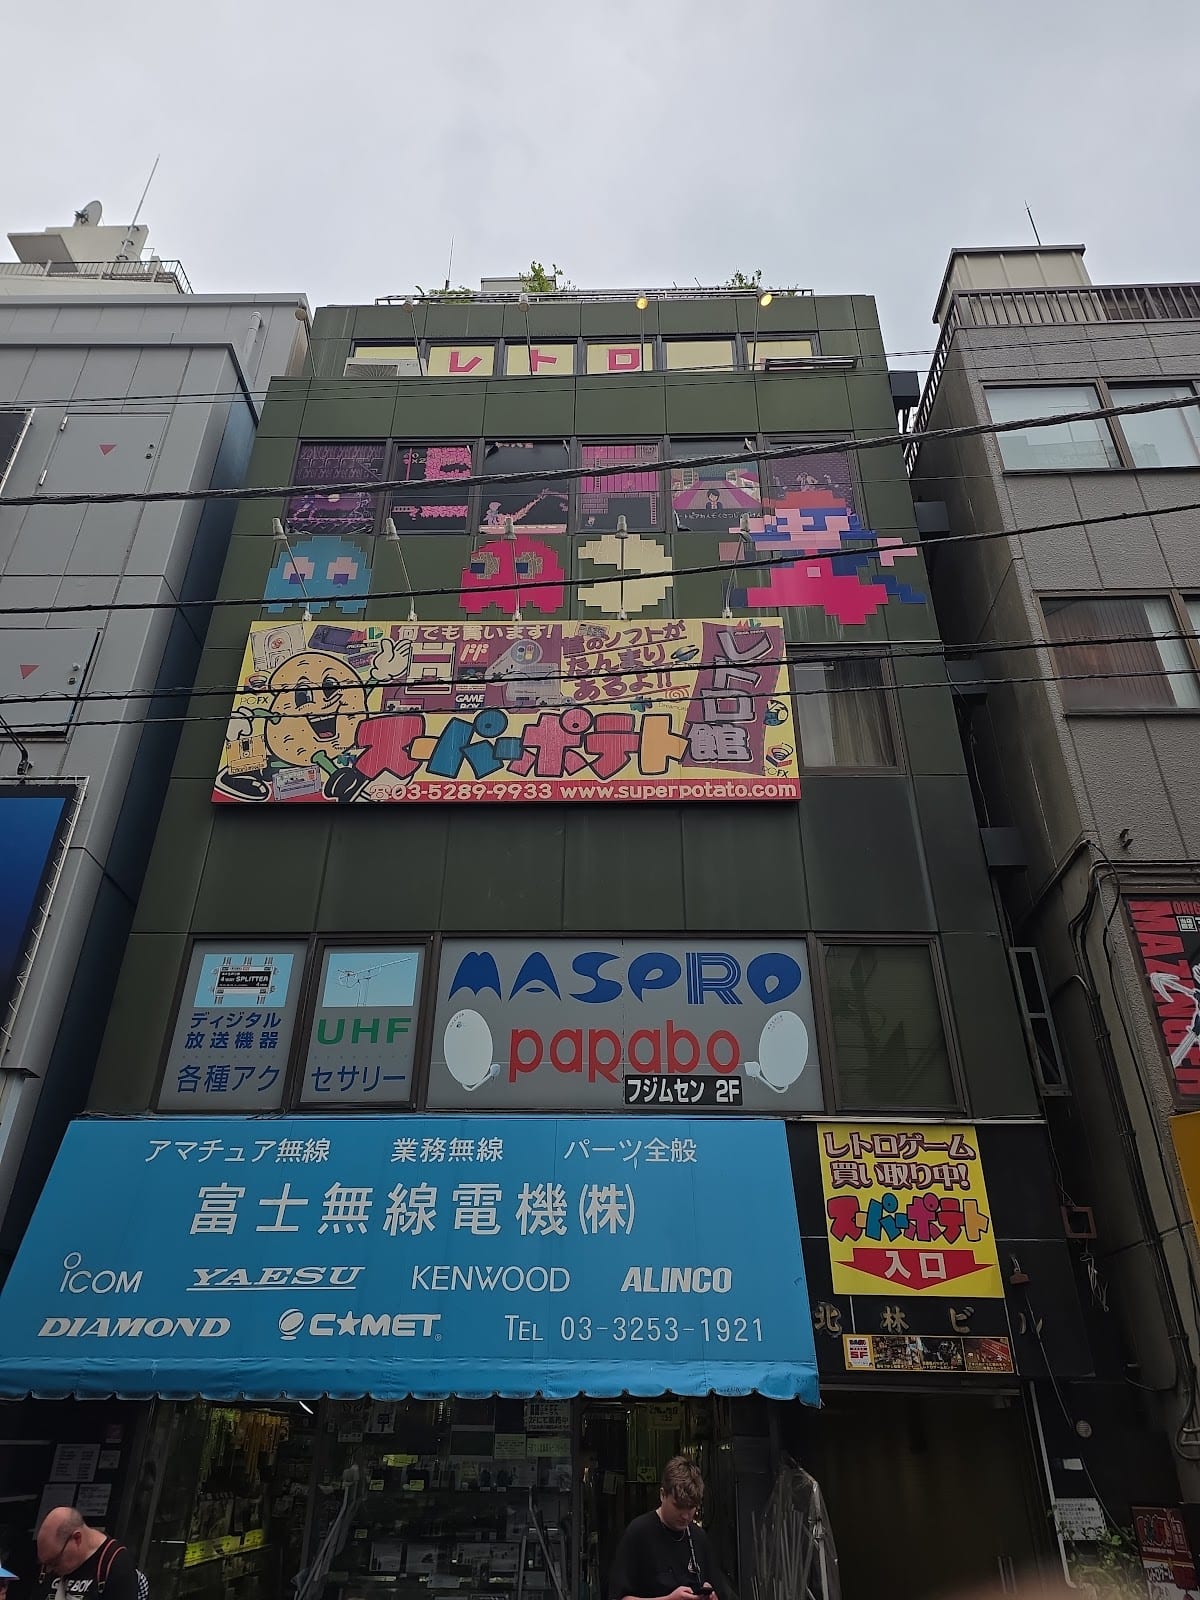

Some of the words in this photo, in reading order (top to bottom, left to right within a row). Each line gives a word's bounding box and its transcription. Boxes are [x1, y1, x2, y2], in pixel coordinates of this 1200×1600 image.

[398, 624, 554, 641] 何でも買います!
[455, 694, 485, 703] GAME
[355, 707, 689, 780] スーパーポテト
[390, 783, 552, 802] 03-5289-9933
[559, 782, 797, 801] www.superpotato.com
[235, 975, 269, 983] SPLITTER
[448, 951, 802, 1005] MASPRO
[190, 1012, 282, 1030] ディジタル
[317, 1017, 412, 1046] UHF
[184, 1031, 279, 1050] 放送機器
[177, 1064, 280, 1093] 各種アク
[311, 1066, 407, 1093] セサリー
[627, 1078, 705, 1104] フジムセン
[714, 1079, 741, 1103] 2F
[144, 1139, 330, 1164] アマチュア無線
[391, 1138, 504, 1163] 業務無線
[564, 1137, 698, 1165] パーツ全般
[824, 1131, 975, 1160] レトロゲーム
[831, 1161, 970, 1190] 買い取り中!
[189, 1182, 636, 1238] 富士無線電機(株)
[826, 1192, 990, 1244] スーパーポテト
[189, 1266, 364, 1289] YAESU
[411, 1265, 570, 1293] KENWOOD
[883, 1250, 949, 1281] 入口
[620, 1266, 733, 1294] ALINCO
[37, 1317, 231, 1338] DIAMOND
[561, 1316, 764, 1343] 03-3253-1921
[50, 1577, 74, 1591] GE
